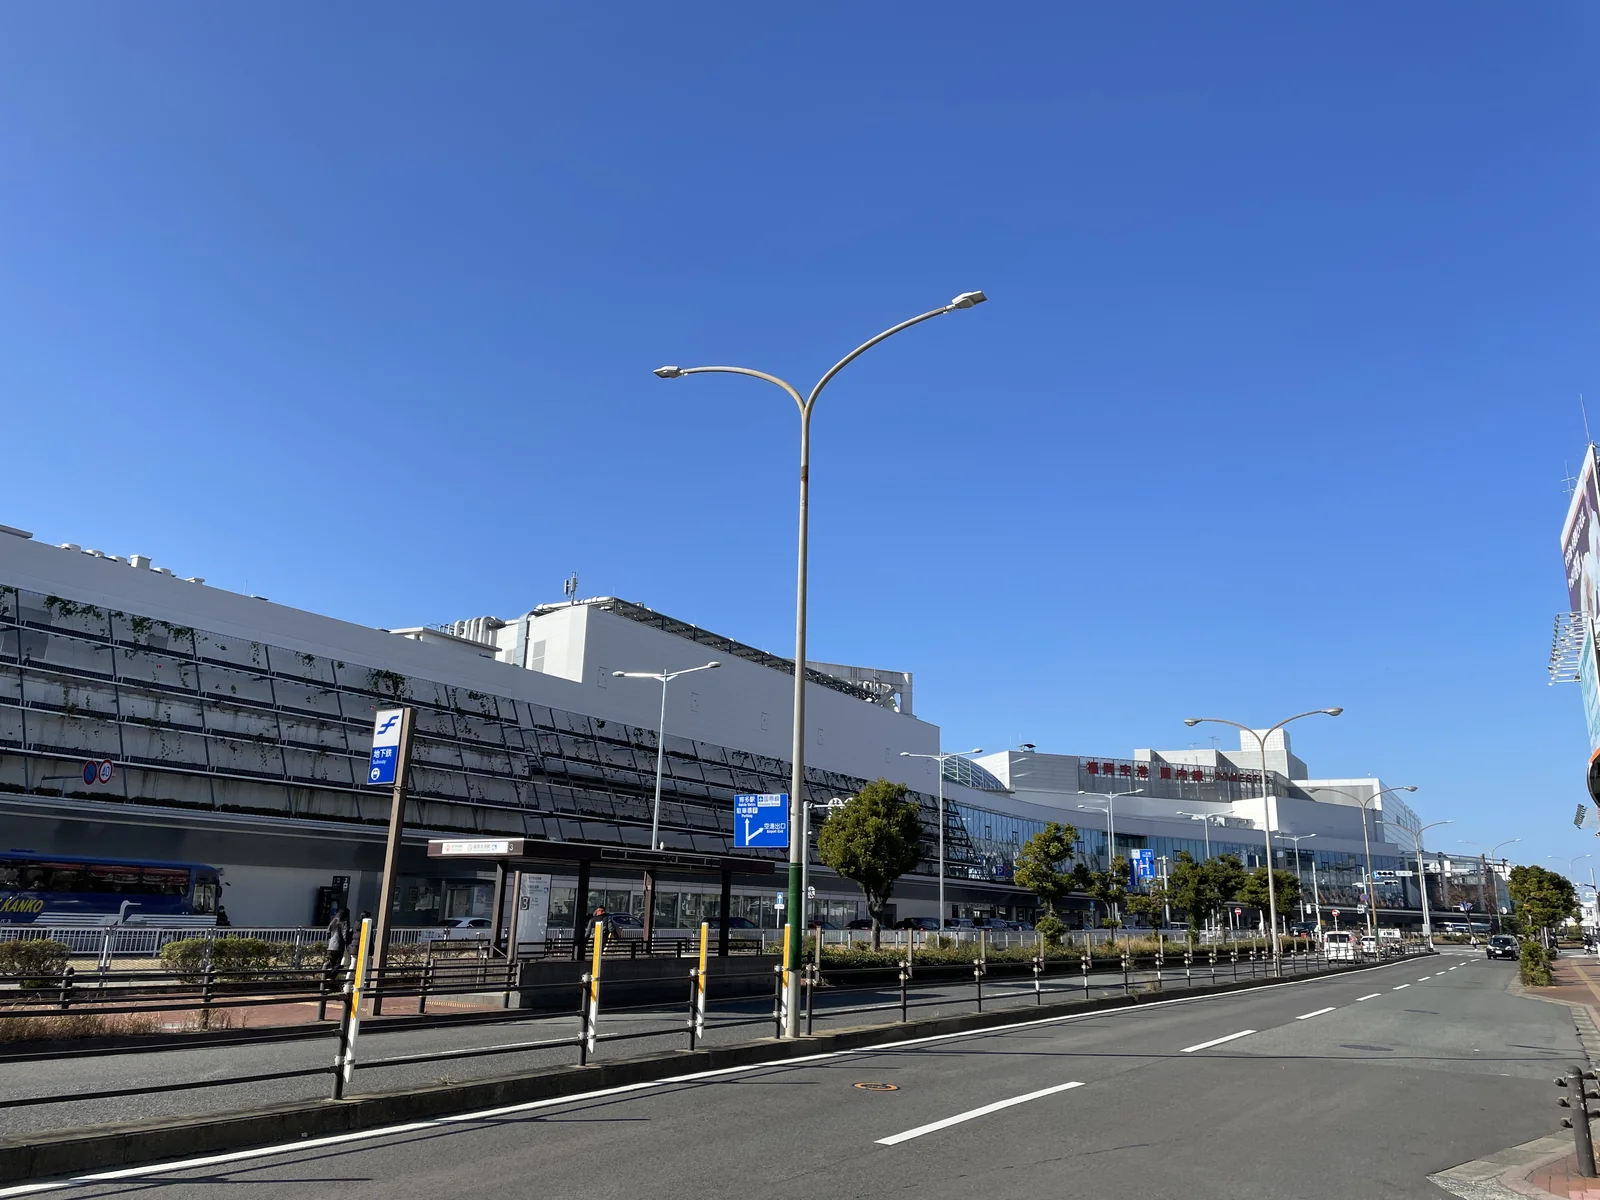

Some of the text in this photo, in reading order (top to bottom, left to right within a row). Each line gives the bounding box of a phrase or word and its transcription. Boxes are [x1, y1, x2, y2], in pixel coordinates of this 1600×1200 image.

[373, 748, 392, 758] 地下鉄
[1087, 761, 1149, 778] 福岡空港
[1160, 767, 1203, 782] 国内線
[0, 899, 44, 913] KANKO
[521, 897, 529, 910] 3
